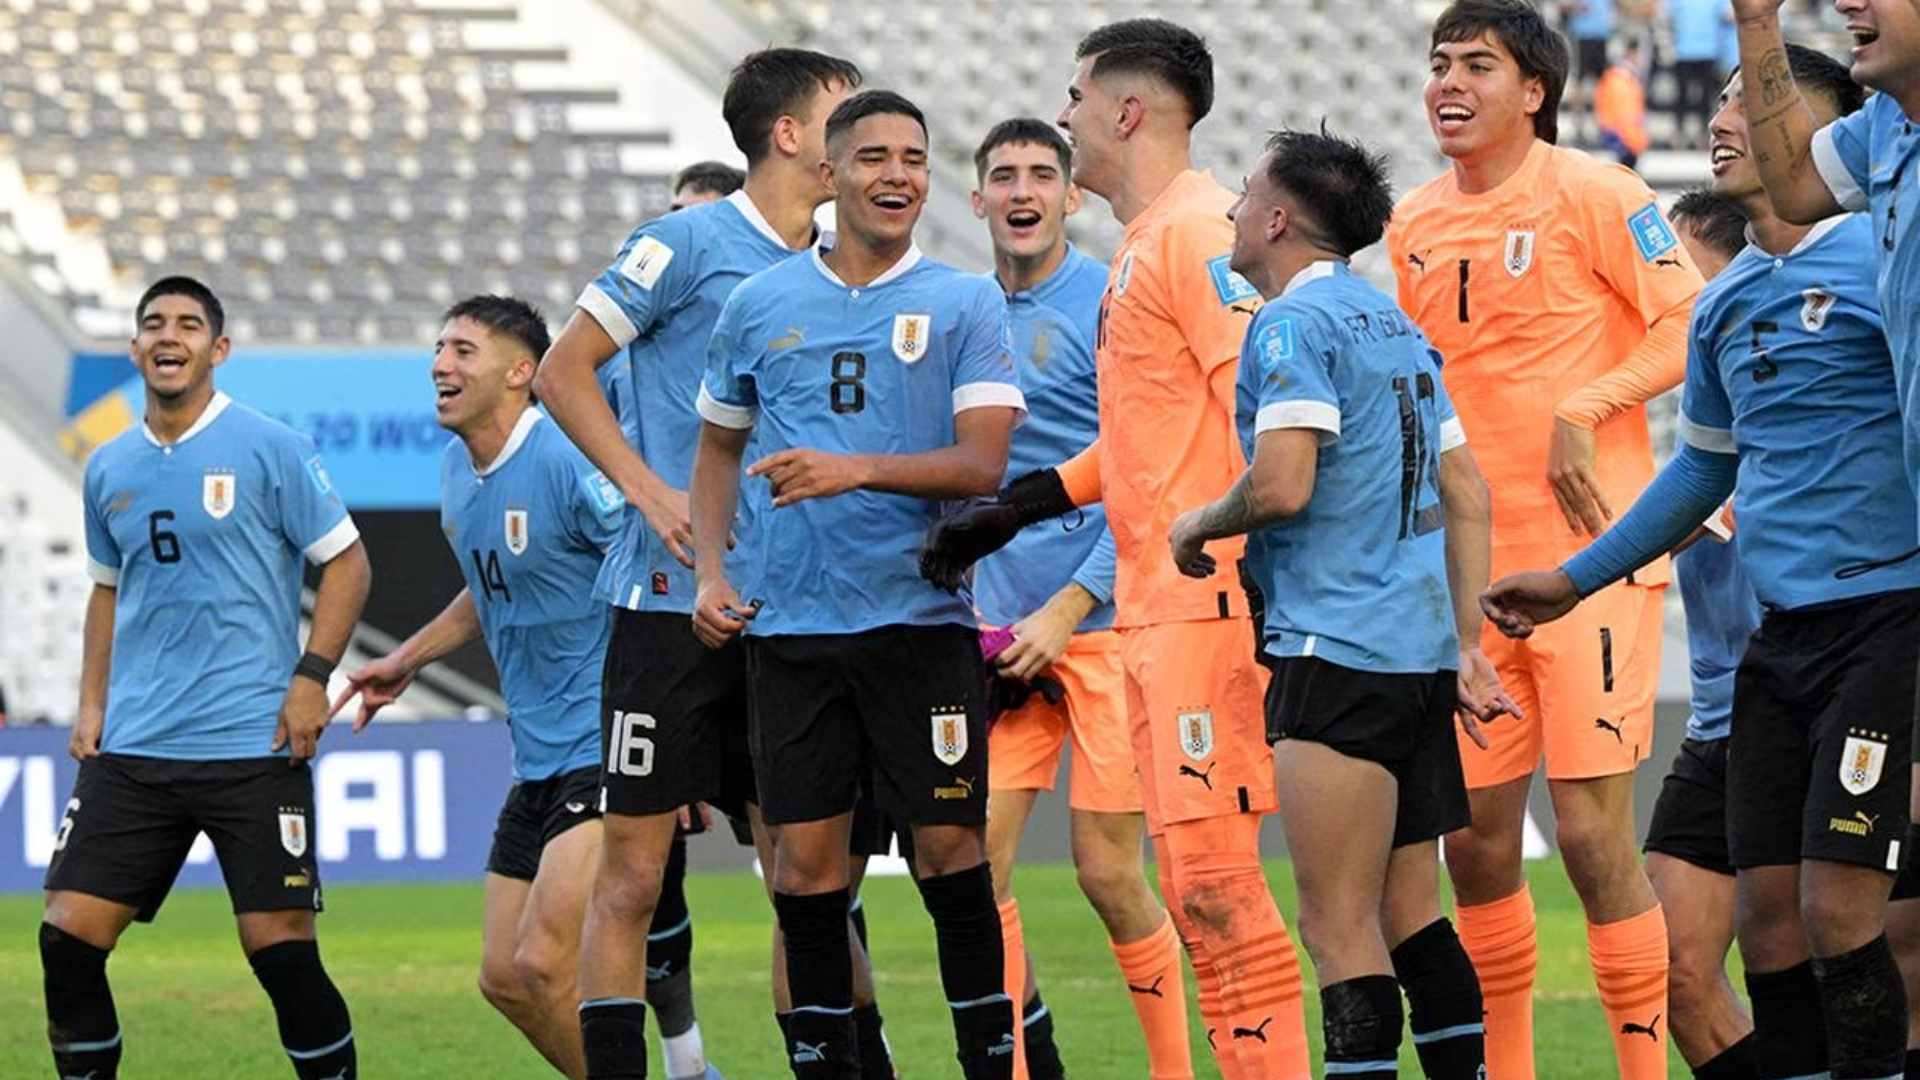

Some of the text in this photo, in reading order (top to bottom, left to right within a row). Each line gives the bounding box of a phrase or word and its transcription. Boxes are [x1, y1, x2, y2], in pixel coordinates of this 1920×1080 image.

[1459, 259, 1470, 323] 1
[829, 351, 867, 416] 8
[1751, 321, 1779, 384] 5
[148, 510, 181, 565] 6
[471, 548, 512, 603] 14
[1600, 627, 1614, 693] 1
[607, 709, 657, 777] 16
[1829, 816, 1867, 837] PUMA
